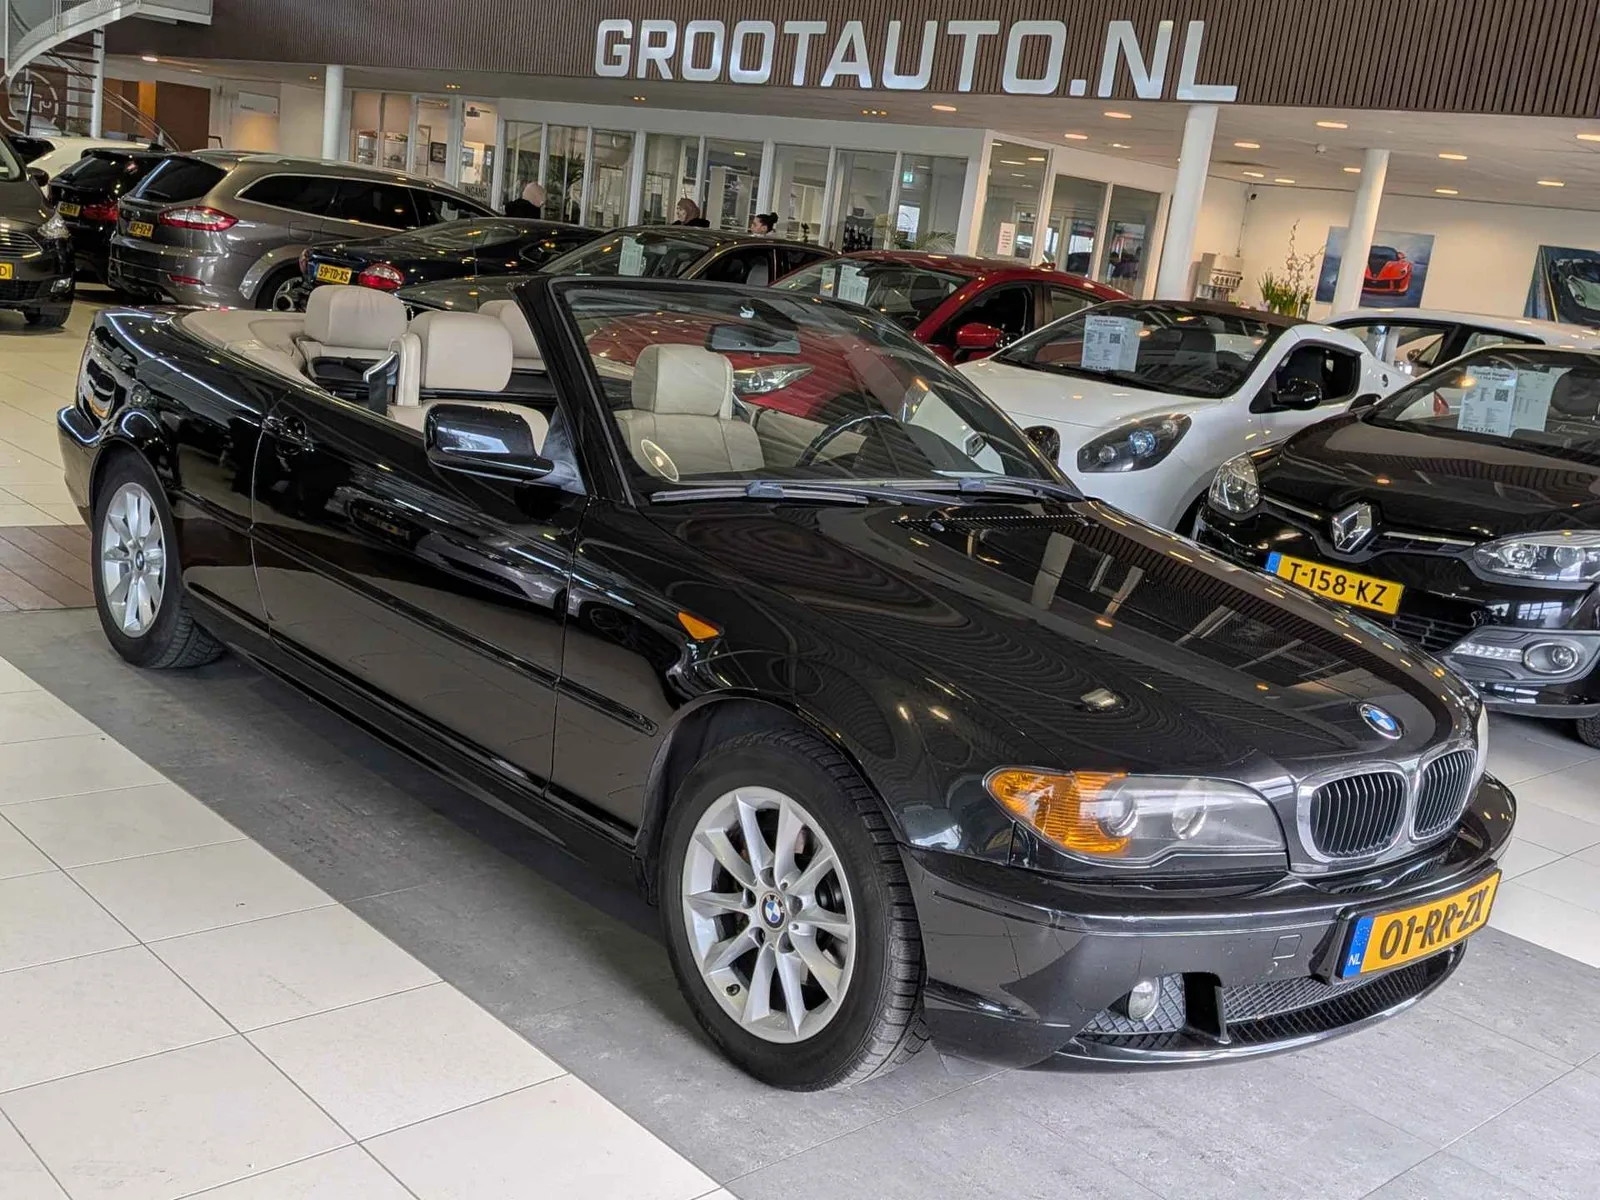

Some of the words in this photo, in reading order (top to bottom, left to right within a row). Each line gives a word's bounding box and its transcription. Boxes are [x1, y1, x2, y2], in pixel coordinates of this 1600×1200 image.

[595, 19, 1238, 101] GROOTAUTO.NL
[465, 185, 488, 198] INGANG
[1290, 562, 1388, 606] T-158-KZ
[1380, 885, 1490, 960] 01-RR-ZX
[1347, 952, 1361, 966] NL
